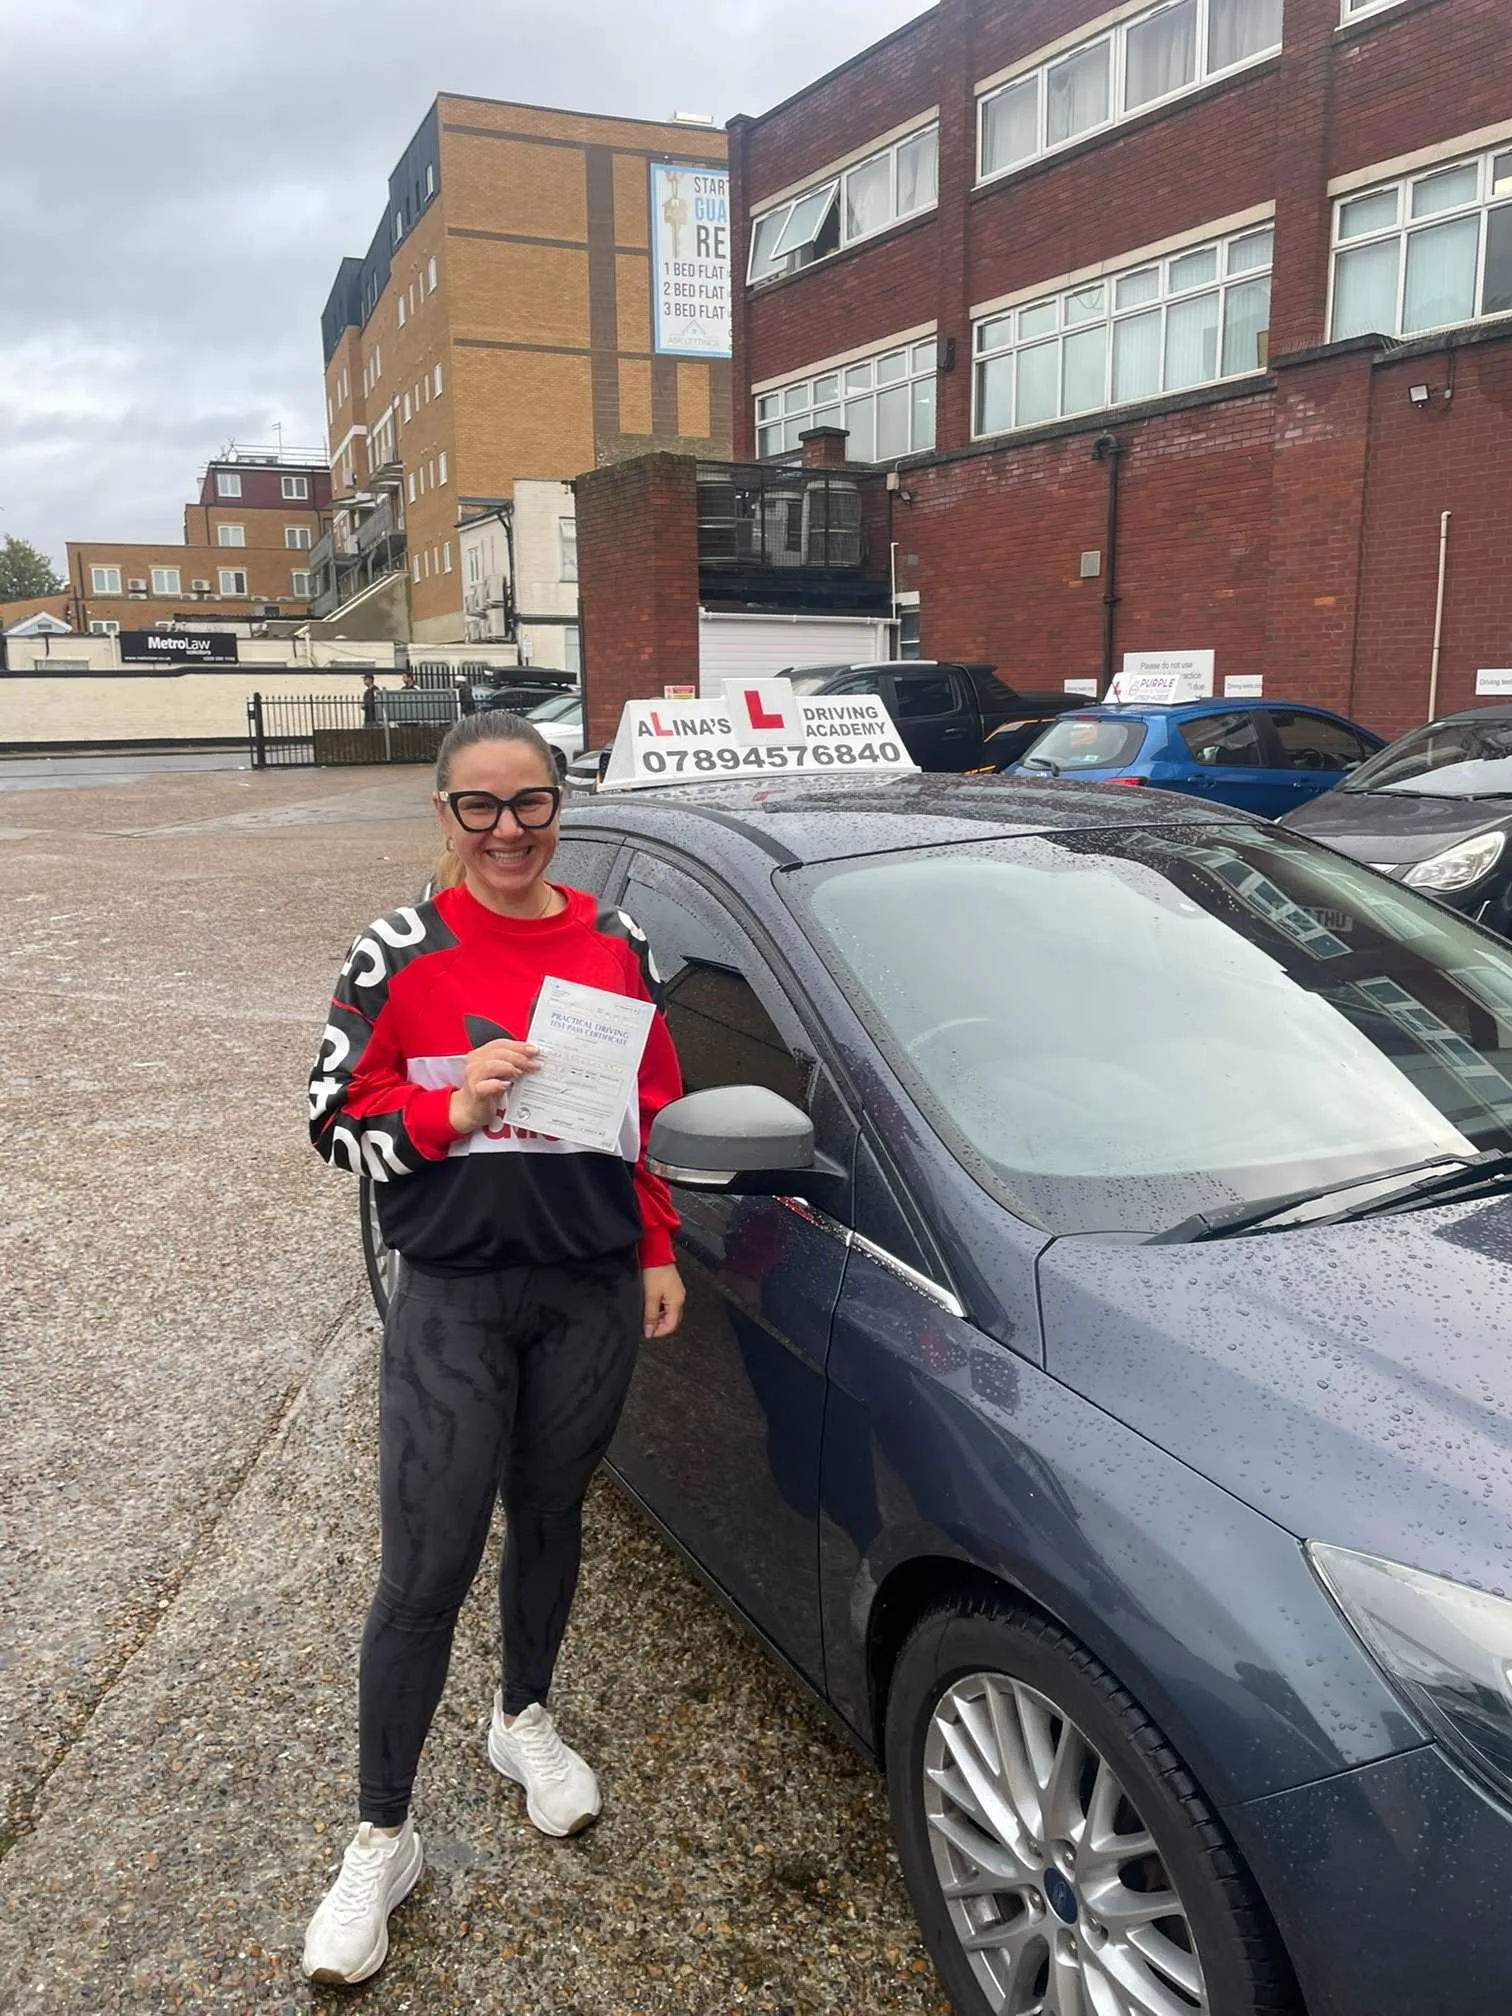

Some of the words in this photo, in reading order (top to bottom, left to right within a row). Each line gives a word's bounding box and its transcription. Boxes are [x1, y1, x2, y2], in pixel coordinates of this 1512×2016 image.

[694, 177, 730, 196] STAR
[664, 262, 669, 275] 1
[674, 263, 695, 278] BED
[699, 264, 724, 280] FLAT
[664, 282, 670, 296] 2
[675, 283, 695, 298] BED
[699, 285, 725, 300] FLAT
[664, 302, 671, 316] 3
[675, 303, 695, 318] BED
[699, 305, 725, 320] FLAT
[148, 636, 211, 650] MetroLaw
[1140, 678, 1175, 688] PURPLE
[744, 690, 785, 729] L
[803, 706, 878, 721] DRIVING
[638, 712, 732, 737] ALINA'S
[805, 722, 886, 737] ACADEMY
[642, 742, 900, 773] 07894576840
[552, 1012, 592, 1029] PRACTICAL
[595, 1023, 629, 1039] DRIVING
[585, 1029, 627, 1046] CERTIFICATE
